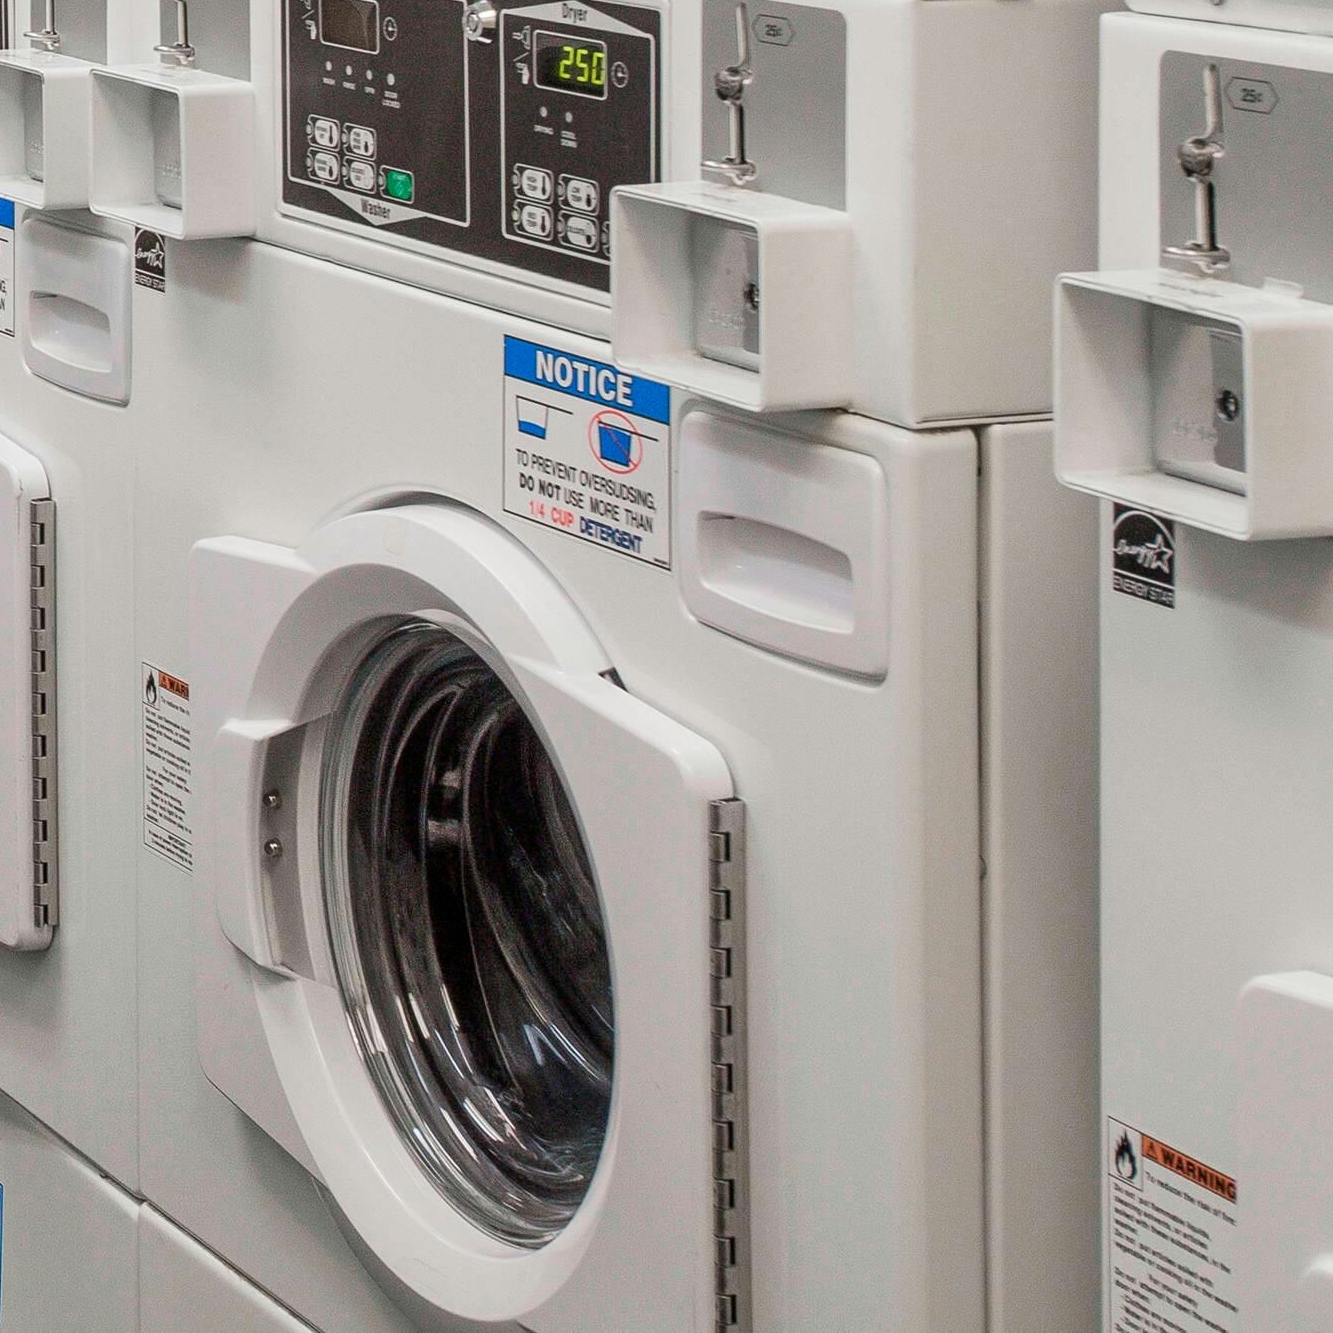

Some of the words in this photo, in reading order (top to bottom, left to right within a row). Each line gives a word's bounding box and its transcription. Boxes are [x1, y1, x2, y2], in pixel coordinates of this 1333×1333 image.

[562, 3, 588, 23] Dryer
[559, 46, 605, 85] 250
[361, 198, 391, 219] Washer
[535, 351, 633, 407] NOTICE
[516, 447, 528, 467] TO
[531, 453, 577, 483] PREVENT
[579, 470, 657, 512] OVERSUDSING,
[519, 472, 535, 492] DO
[538, 477, 562, 498] NOT
[564, 484, 584, 510] USE
[589, 496, 620, 522] MORE
[623, 508, 653, 533] THAN
[529, 499, 545, 517] 1/4
[551, 506, 574, 528] CUP
[579, 515, 643, 554] DETERGENT
[1157, 1179, 1182, 1197] reduce
[1183, 1192, 1195, 1204] the
[1161, 1147, 1237, 1201] WARNING
